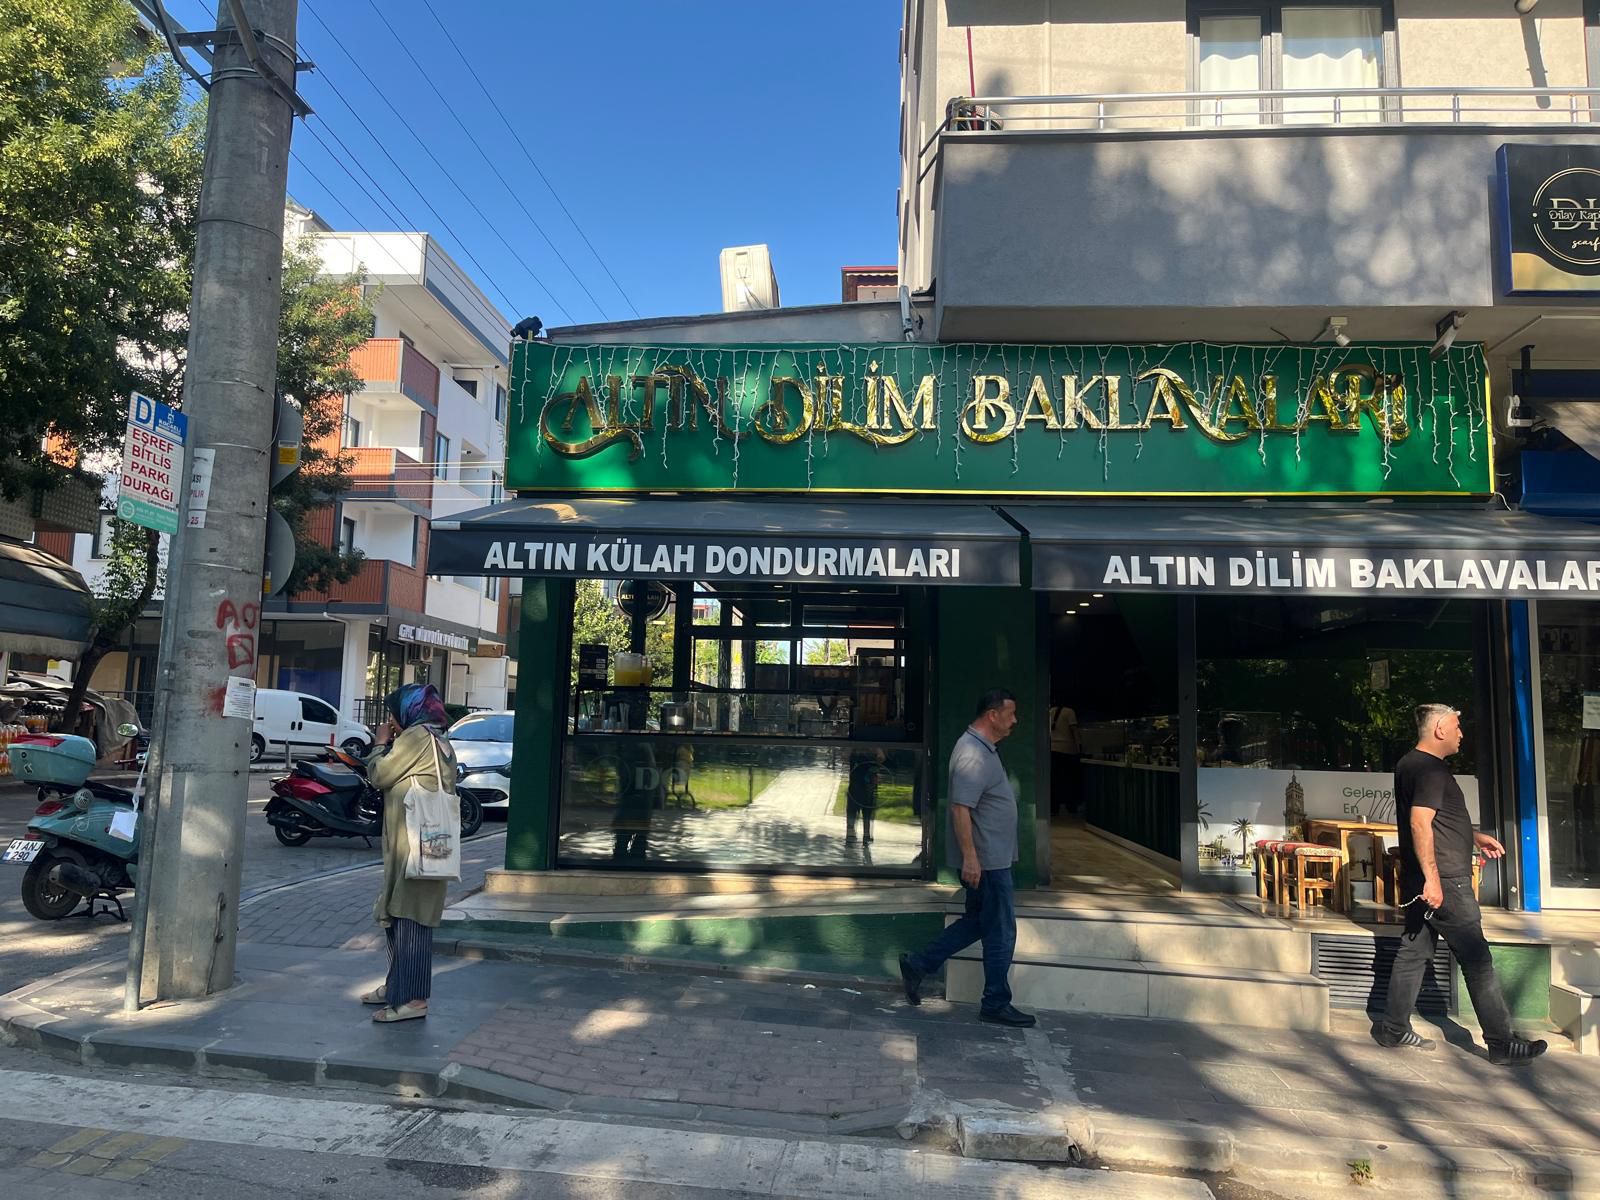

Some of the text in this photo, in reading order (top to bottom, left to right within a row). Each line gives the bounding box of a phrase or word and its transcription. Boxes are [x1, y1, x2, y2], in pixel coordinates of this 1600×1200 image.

[135, 396, 152, 424] D
[541, 359, 1411, 461] ALTIN DİLİM BAKLAVALARI
[132, 427, 174, 454] EŞREF
[131, 444, 172, 470] BİTLİS
[131, 462, 169, 485] PARKI
[123, 475, 173, 502] DURAĞI
[483, 538, 960, 579] ALTIN KÜLAH DONDURMALARI
[1102, 550, 1600, 591] ALTIN DİLİM BAKLAVALAR
[11, 851, 30, 860] 290
[21, 842, 43, 851] ANJ
